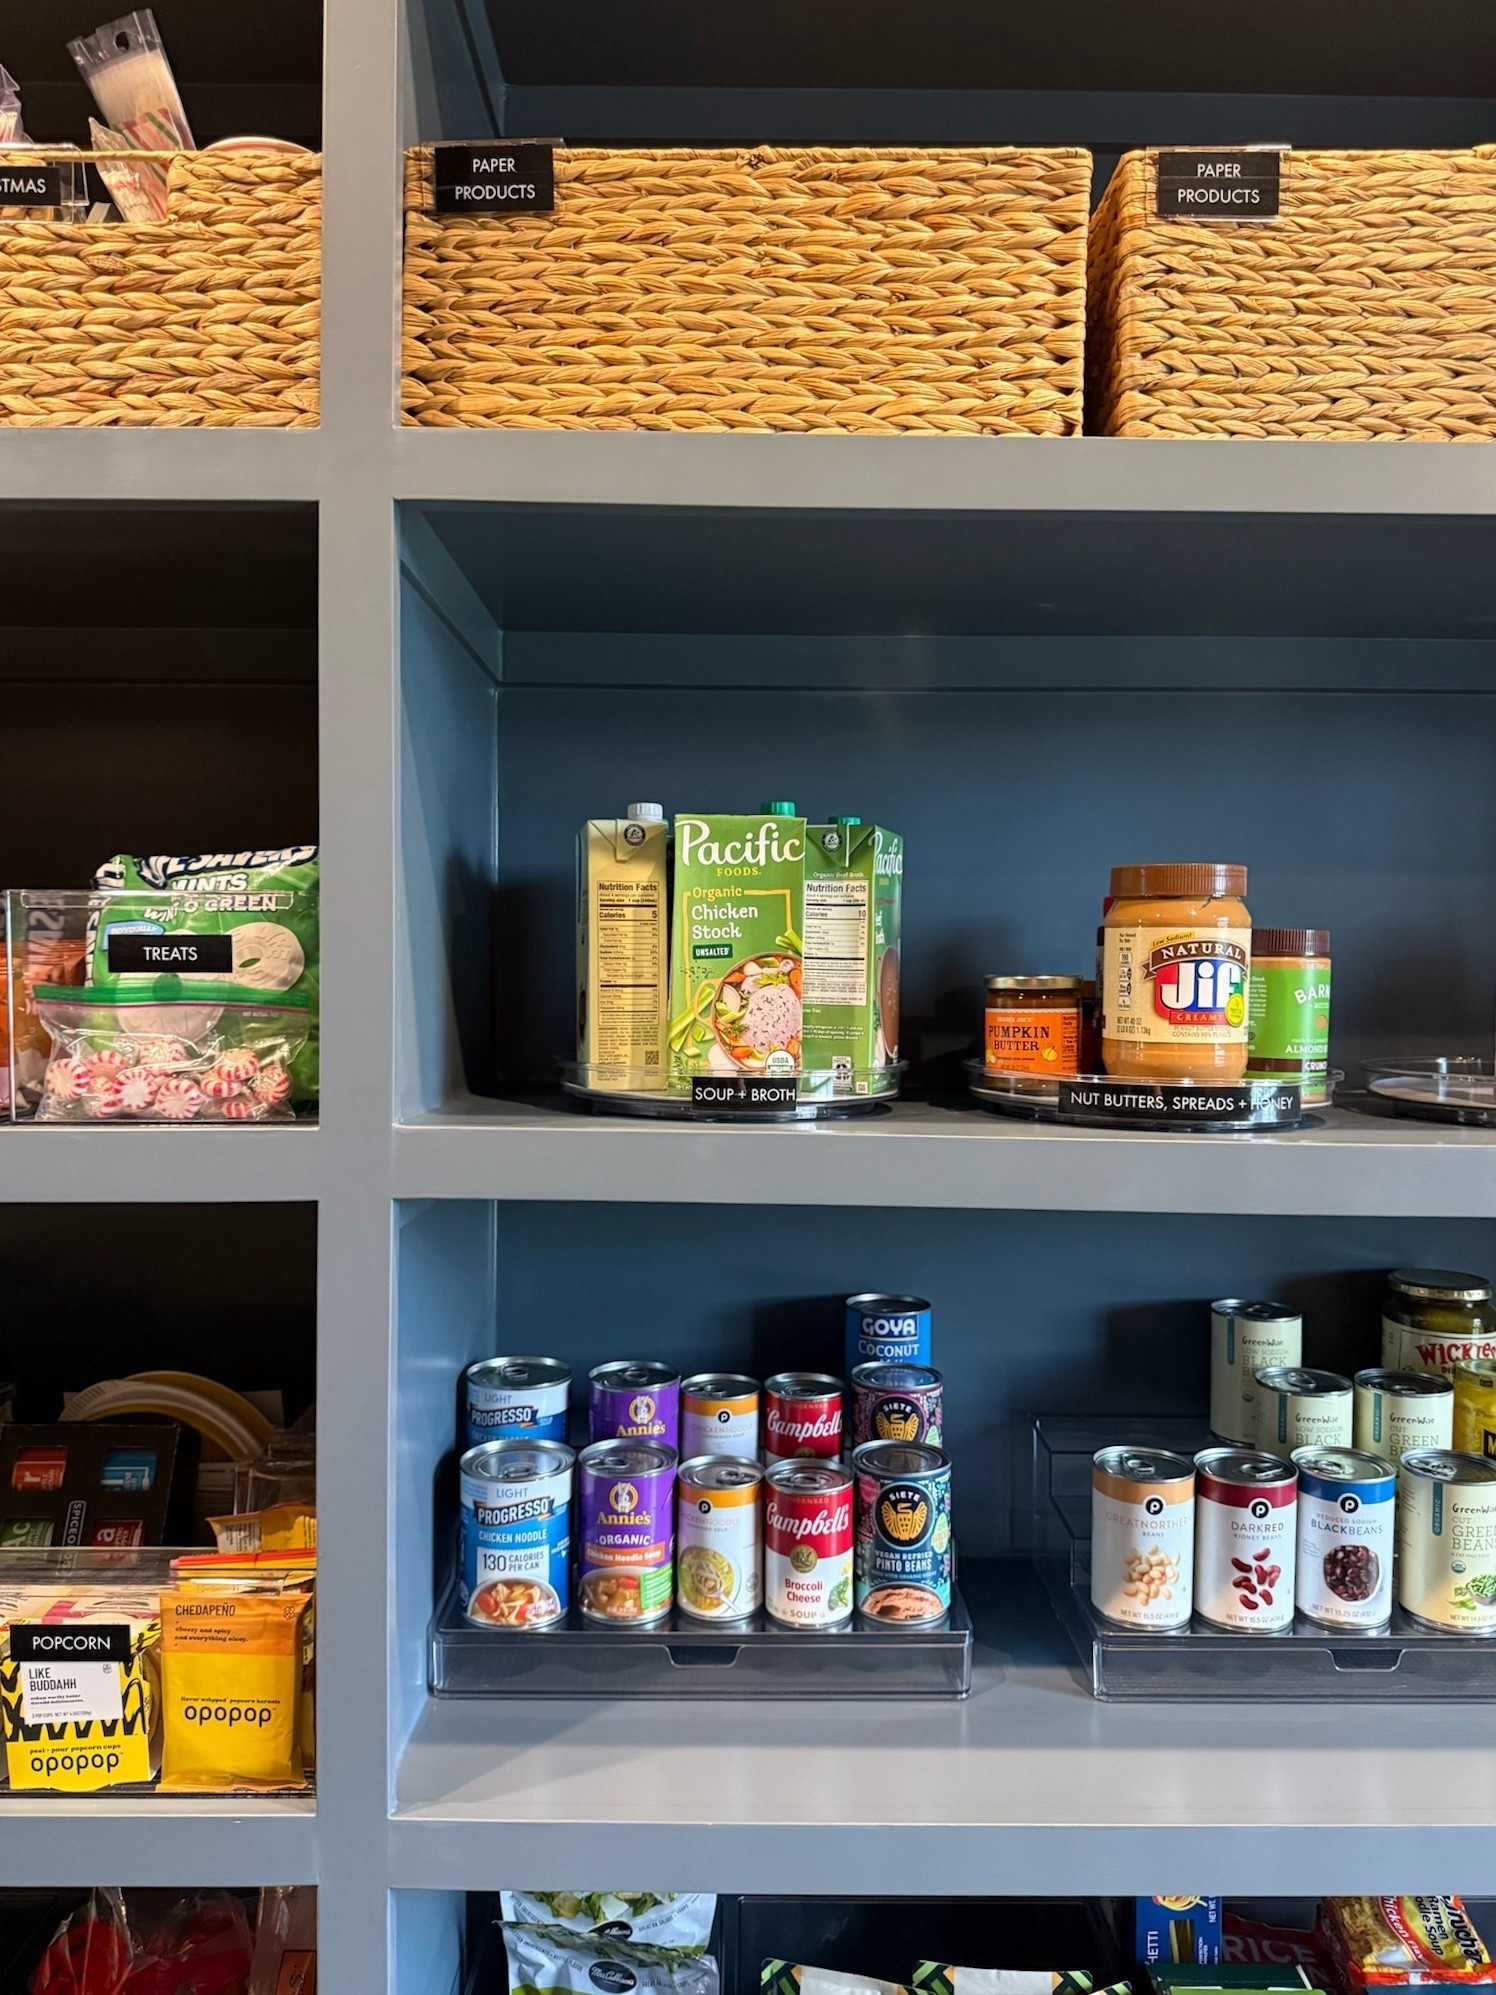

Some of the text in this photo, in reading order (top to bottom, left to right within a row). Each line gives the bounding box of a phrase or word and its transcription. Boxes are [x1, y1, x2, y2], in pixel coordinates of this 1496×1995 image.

[472, 158, 517, 173] PAPER
[1197, 163, 1241, 178] PAPER
[455, 184, 536, 200] PRODUCTS
[1177, 188, 1260, 203] PRODUCTS
[675, 820, 805, 867] Pacific
[868, 832, 903, 877] Pacific
[599, 883, 658, 891] Nutrition Facts
[692, 886, 742, 901] Organic
[806, 883, 867, 892] Nutrition Facts
[204, 895, 277, 912] GREEN
[651, 910, 658, 919] 5
[691, 903, 758, 921] Chicken
[692, 922, 742, 940] Stock
[1152, 932, 1193, 947] Low Sodium!
[143, 946, 198, 961] TREATS
[695, 947, 730, 957] UNSALTED
[1161, 942, 1241, 960] NATURAL
[1161, 961, 1241, 1010] Jif
[988, 1025, 1050, 1038] PUMPKIN
[994, 1040, 1039, 1051] BUTTER
[772, 1056, 789, 1064] USDA
[695, 1087, 734, 1101] SOUP
[751, 1088, 796, 1102] BROTH
[1070, 1092, 1100, 1106] NUT
[1104, 1094, 1169, 1111] BUTTERS,
[1172, 1097, 1234, 1111] SPREADS
[1250, 1096, 1293, 1110] HONEY
[862, 1317, 916, 1336] GOYA
[1242, 1355, 1287, 1366] BLACK
[484, 1393, 512, 1404] LIGHT
[883, 1402, 912, 1413] SIETE
[472, 1408, 532, 1426] PROGRESSO
[616, 1420, 667, 1437] Annie's
[1295, 1433, 1341, 1445] BLACK
[1389, 1433, 1440, 1446] GREEN
[496, 1488, 529, 1498] LIGHT
[889, 1490, 921, 1501] SIETE
[477, 1499, 549, 1525] PROGRESSO
[597, 1510, 652, 1526] Annie's
[766, 1502, 849, 1540] Campbell's
[1452, 1516, 1472, 1524] CUT
[478, 1529, 548, 1543] CHICKEN NOODLE
[599, 1534, 651, 1545] ORGANIC
[508, 1551, 545, 1563] CALORIES
[875, 1550, 900, 1560] VEGAN
[483, 1554, 507, 1572] 130
[508, 1562, 540, 1572] PER CAN
[876, 1557, 933, 1572] PINTO BEANS
[785, 1578, 823, 1591] Broccoli
[786, 1591, 821, 1603] Cheese
[175, 1602, 236, 1617] CHEDAPEÑO
[790, 1609, 817, 1619] SOUP
[32, 1636, 111, 1650] POPCORN
[188, 1635, 227, 1643] everything
[29, 1667, 51, 1680] LIKE
[30, 1678, 77, 1692] BUDDAHH
[184, 1706, 271, 1728] opopop
[70, 1745, 102, 1753] popcorn
[31, 1753, 119, 1776] opopop
[1208, 1911, 1216, 1923] NET
[1428, 1896, 1449, 1940] Ramen
[1415, 1897, 1444, 1956] odle Soup
[1222, 1935, 1318, 1963] RICE
